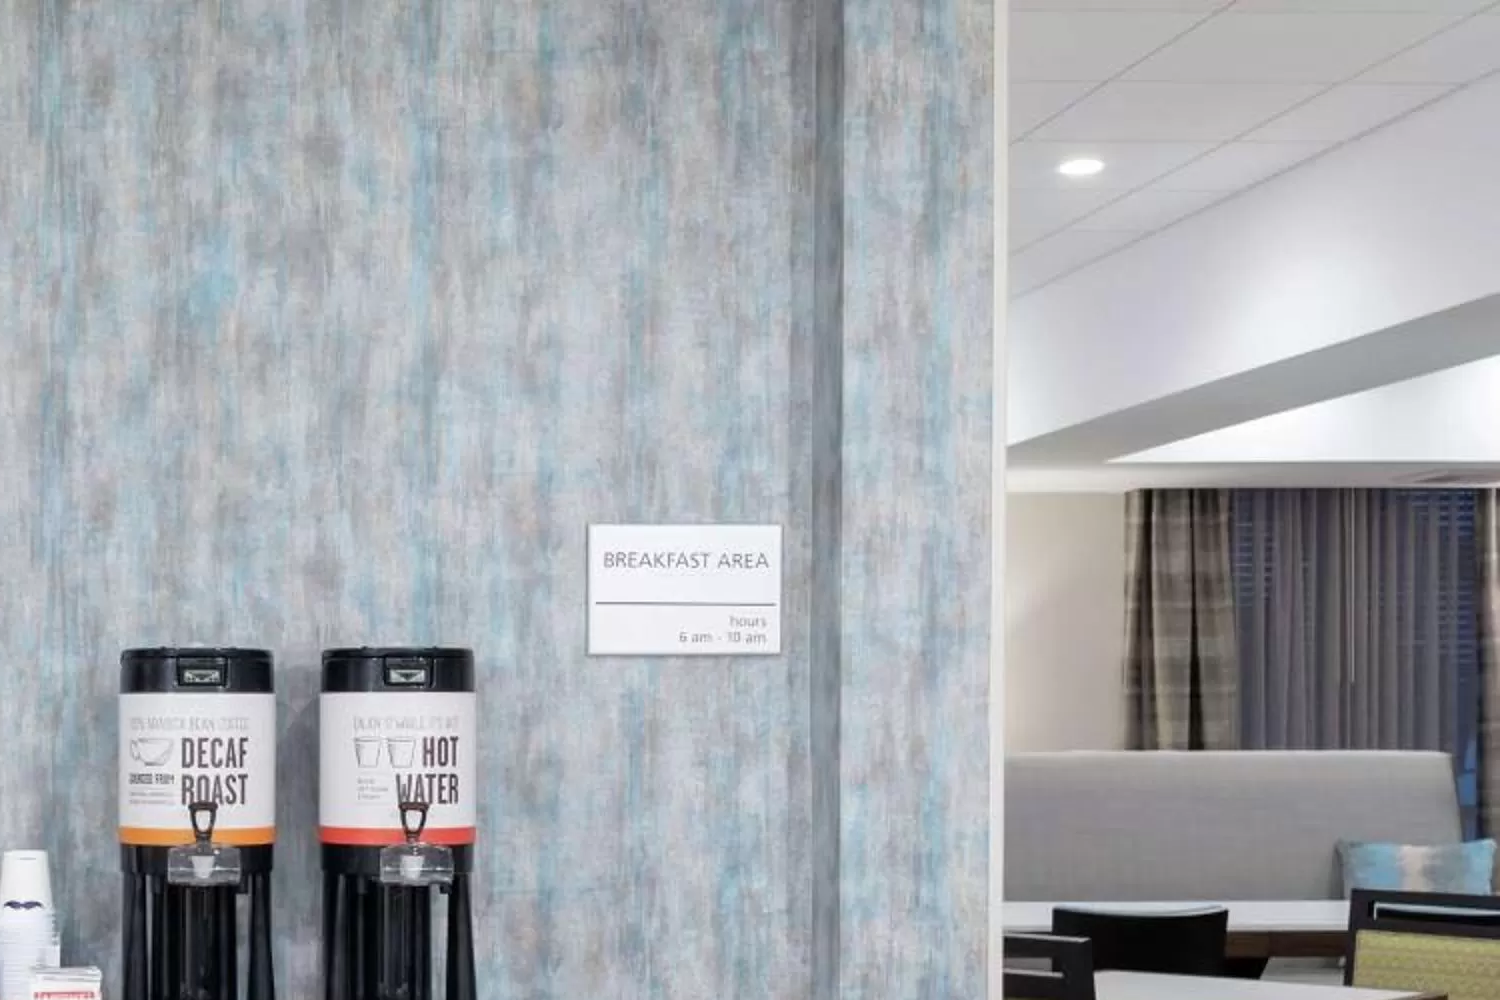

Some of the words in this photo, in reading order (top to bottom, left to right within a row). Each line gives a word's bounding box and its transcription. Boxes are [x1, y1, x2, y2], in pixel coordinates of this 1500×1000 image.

[602, 551, 710, 569] BREAKFAST
[717, 552, 770, 569] AREA
[679, 631, 688, 643] 6
[691, 633, 713, 643] am
[728, 631, 741, 642] 10
[745, 633, 767, 644] am
[728, 615, 767, 628] hours
[181, 737, 249, 769] DECAF
[422, 736, 459, 768] HOT
[181, 773, 248, 805] ROAST
[396, 773, 459, 805] WATER
